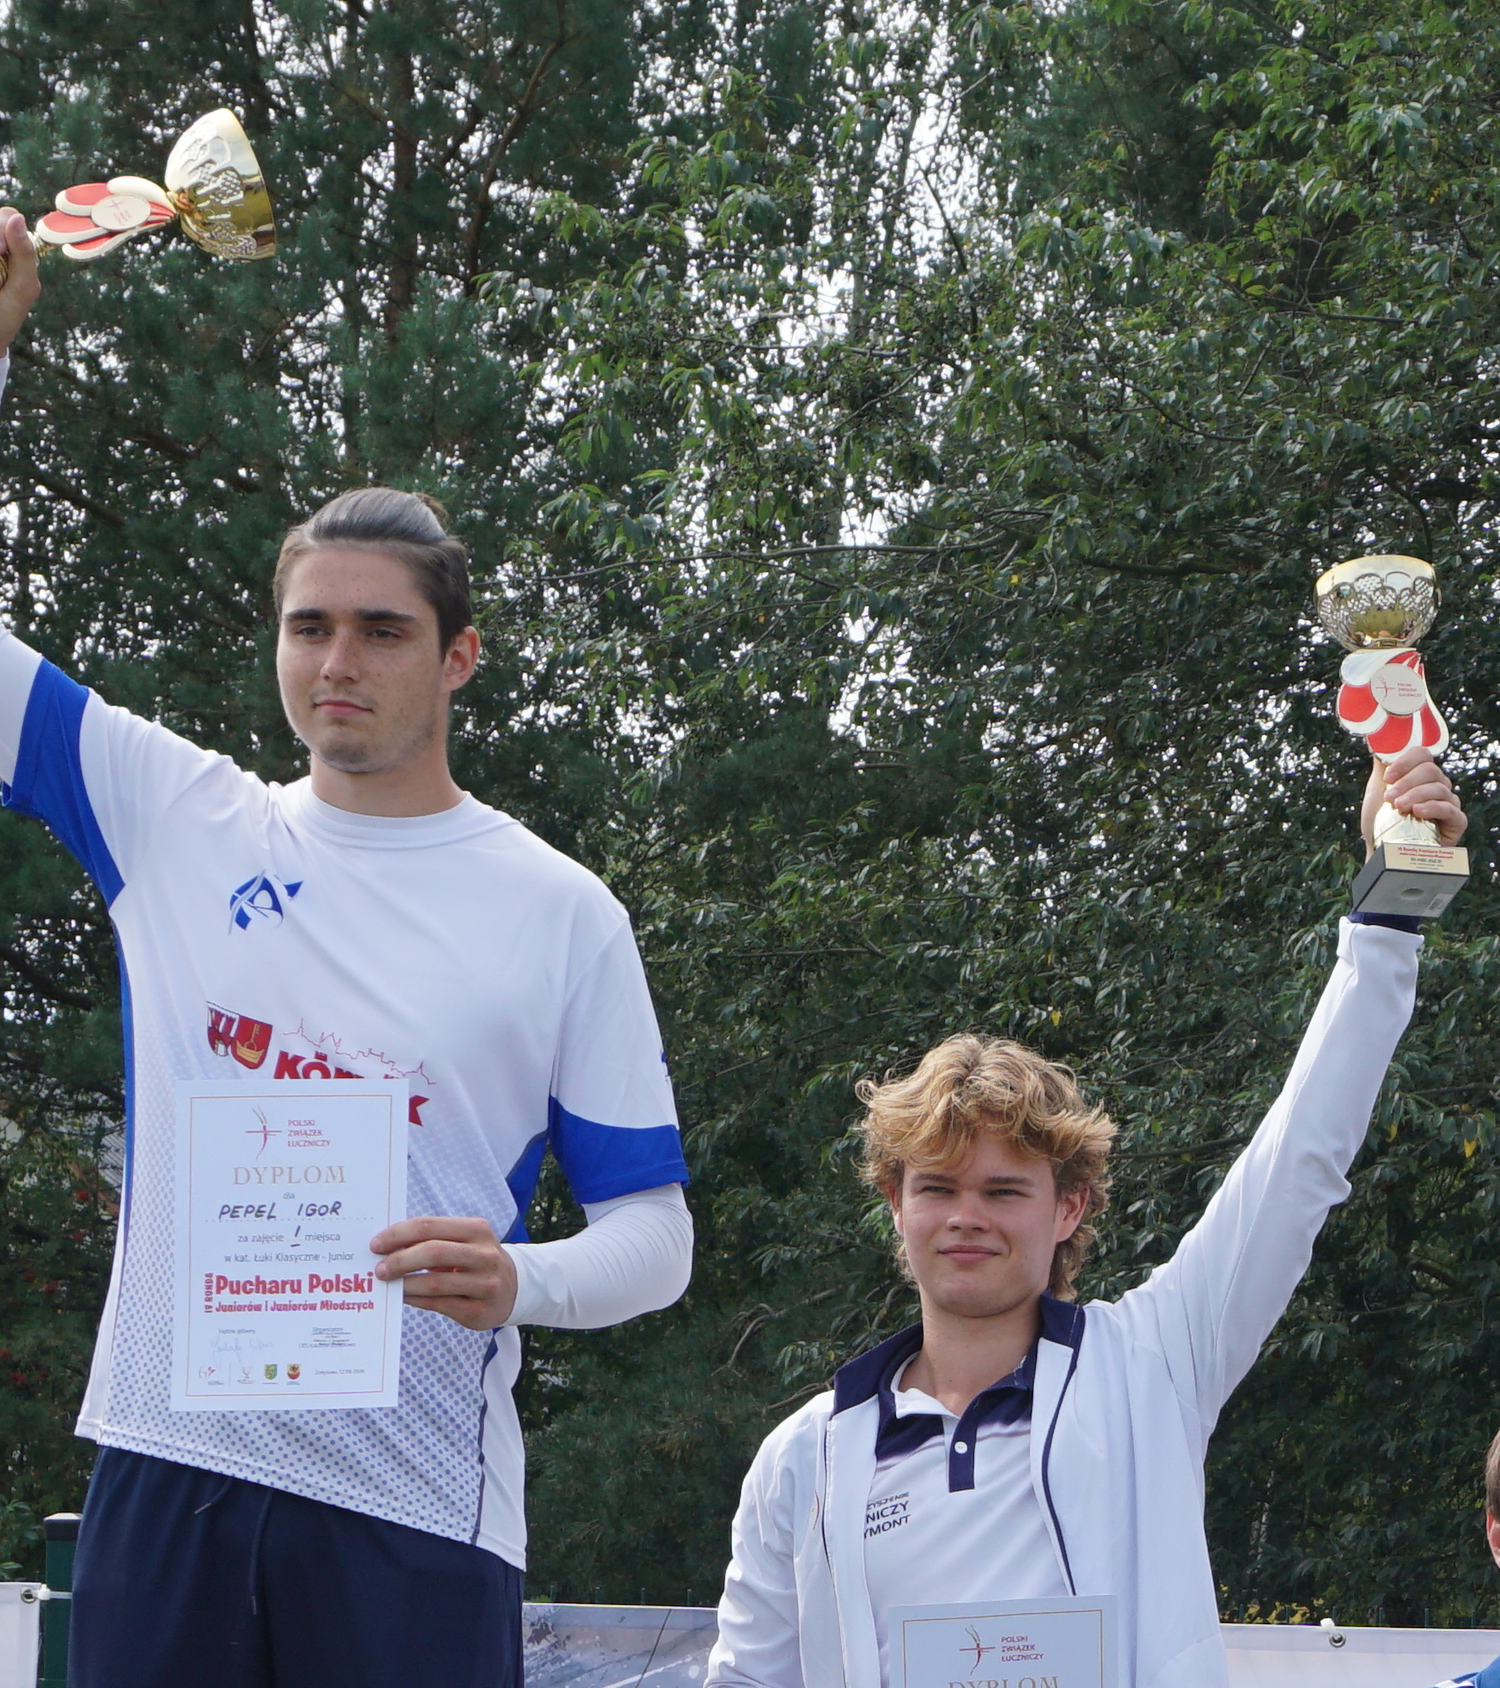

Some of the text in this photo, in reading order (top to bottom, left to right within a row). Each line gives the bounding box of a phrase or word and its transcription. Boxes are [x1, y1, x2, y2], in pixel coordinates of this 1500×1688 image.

[233, 1165, 347, 1185] DYPLOM
[218, 1201, 342, 1220] PEPEL IGOR
[237, 1234, 248, 1242] za
[249, 1233, 284, 1245] zajęcie
[304, 1233, 341, 1245] miejsca
[215, 1271, 373, 1295] Pucharu Polski
[215, 1300, 374, 1314] Juniorów i Juniorów Młodszych
